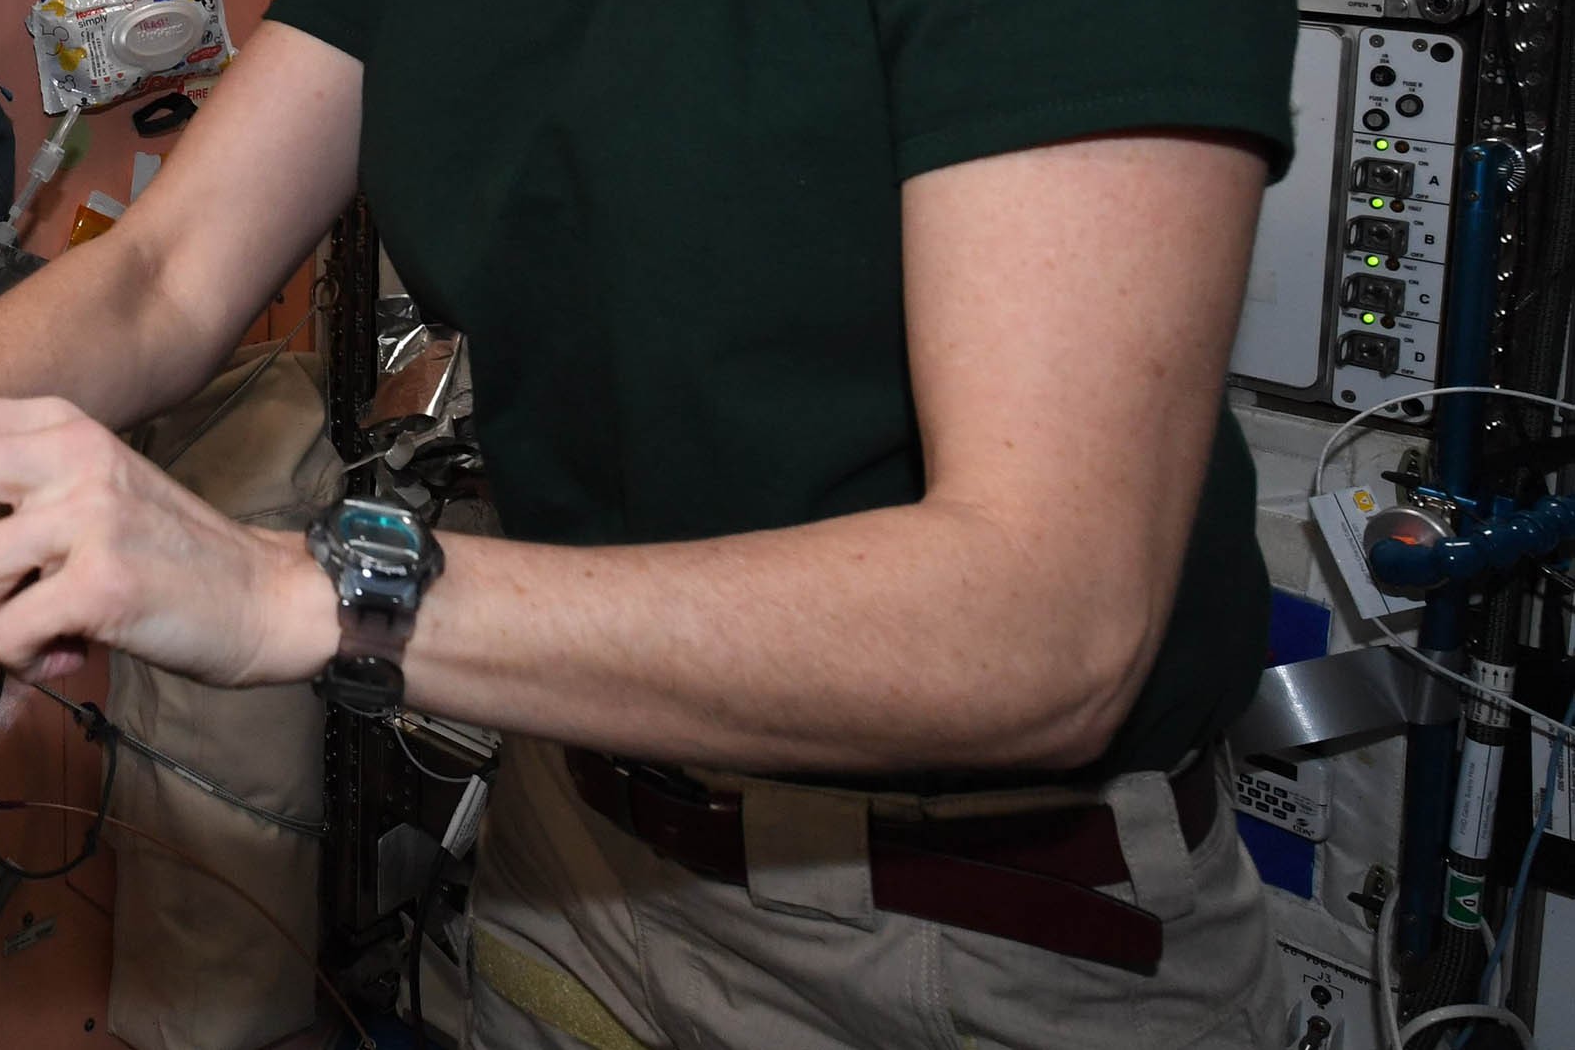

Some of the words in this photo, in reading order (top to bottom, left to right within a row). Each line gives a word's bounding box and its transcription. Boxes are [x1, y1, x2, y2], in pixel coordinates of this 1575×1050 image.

[78, 14, 108, 29] simply
[187, 87, 208, 98] FIRE
[1429, 175, 1440, 186] A
[1425, 234, 1435, 245] B
[1419, 293, 1430, 304] C
[1414, 352, 1425, 362] D
[1317, 972, 1331, 983] J3
